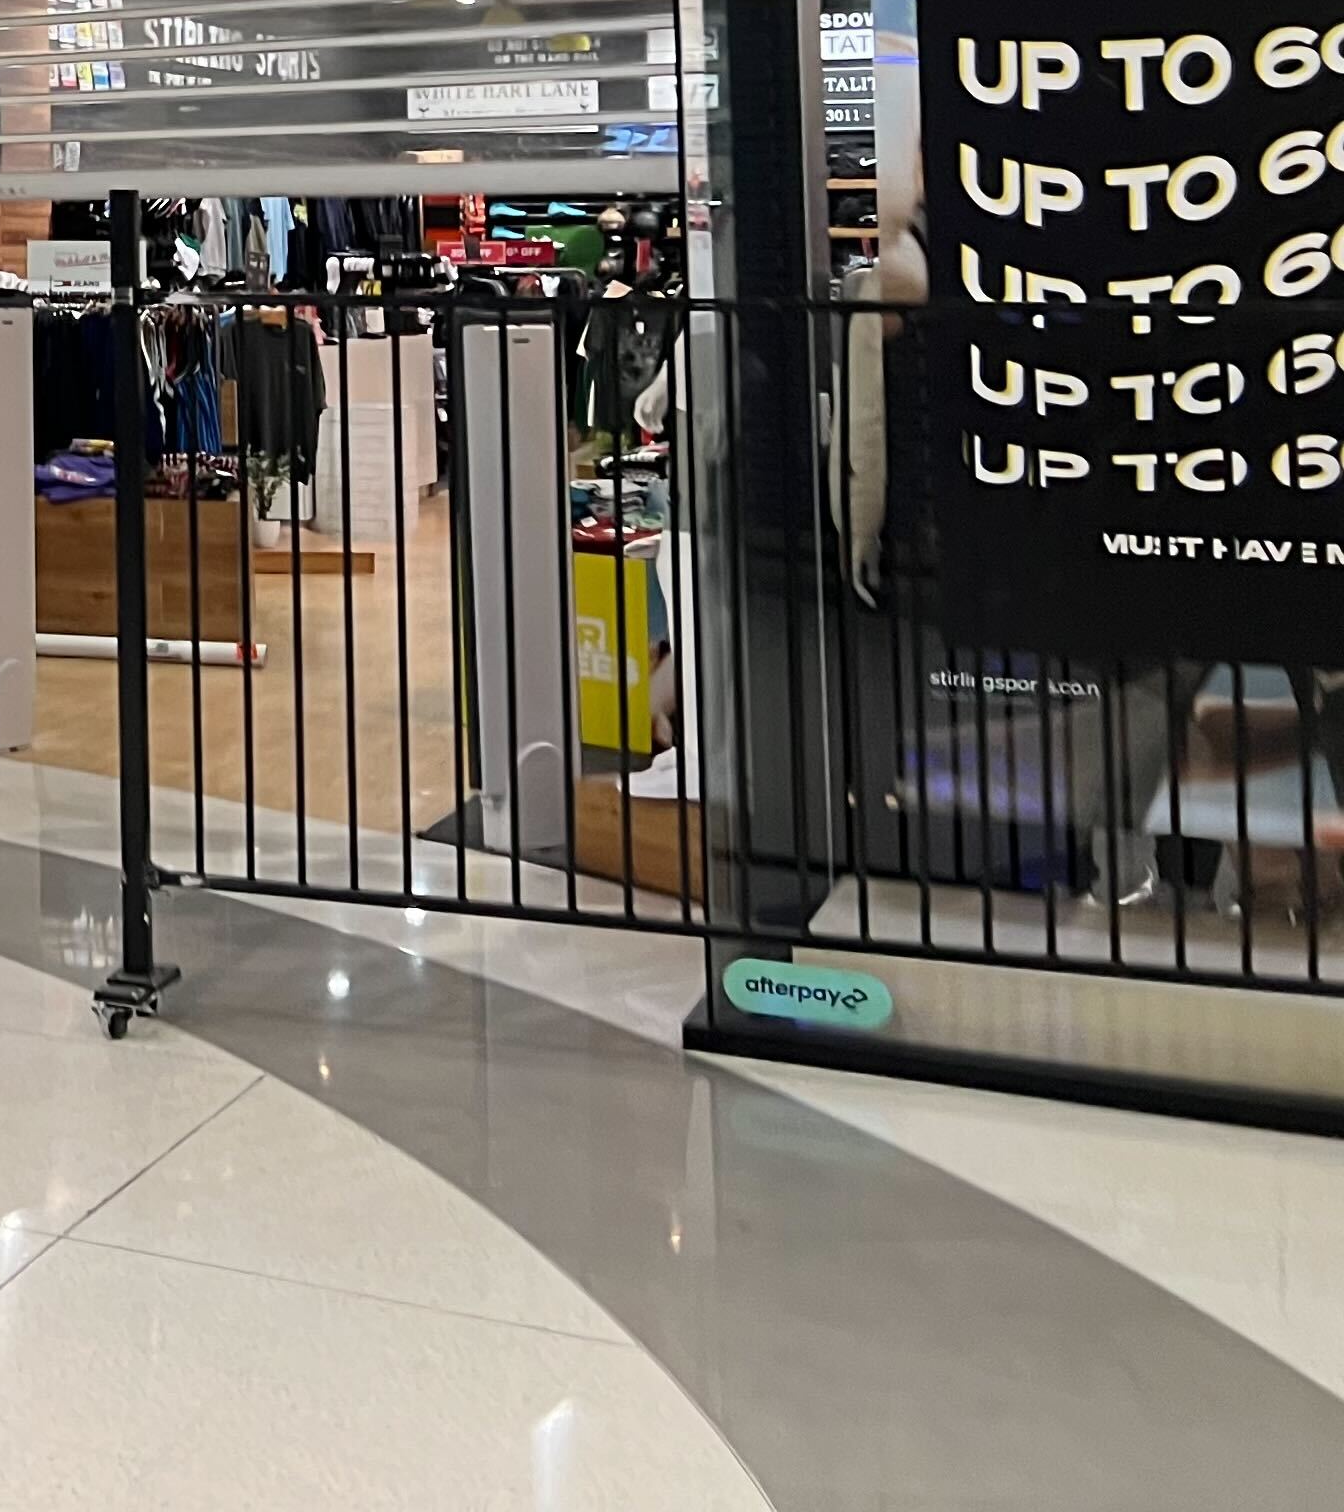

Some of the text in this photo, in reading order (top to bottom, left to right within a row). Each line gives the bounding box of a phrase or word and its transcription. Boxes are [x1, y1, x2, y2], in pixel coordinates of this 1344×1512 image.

[540, 81, 591, 98] LANE
[958, 37, 1081, 111] UP
[1101, 34, 1233, 111] TO
[825, 108, 860, 122] 3011
[960, 142, 1084, 227] UP
[1105, 155, 1238, 231] TO
[961, 226, 1344, 334] UP TO 6
[970, 334, 1344, 421] UP TO 6
[962, 430, 1344, 492] UP TO 6
[745, 976, 842, 1007] afterpay
